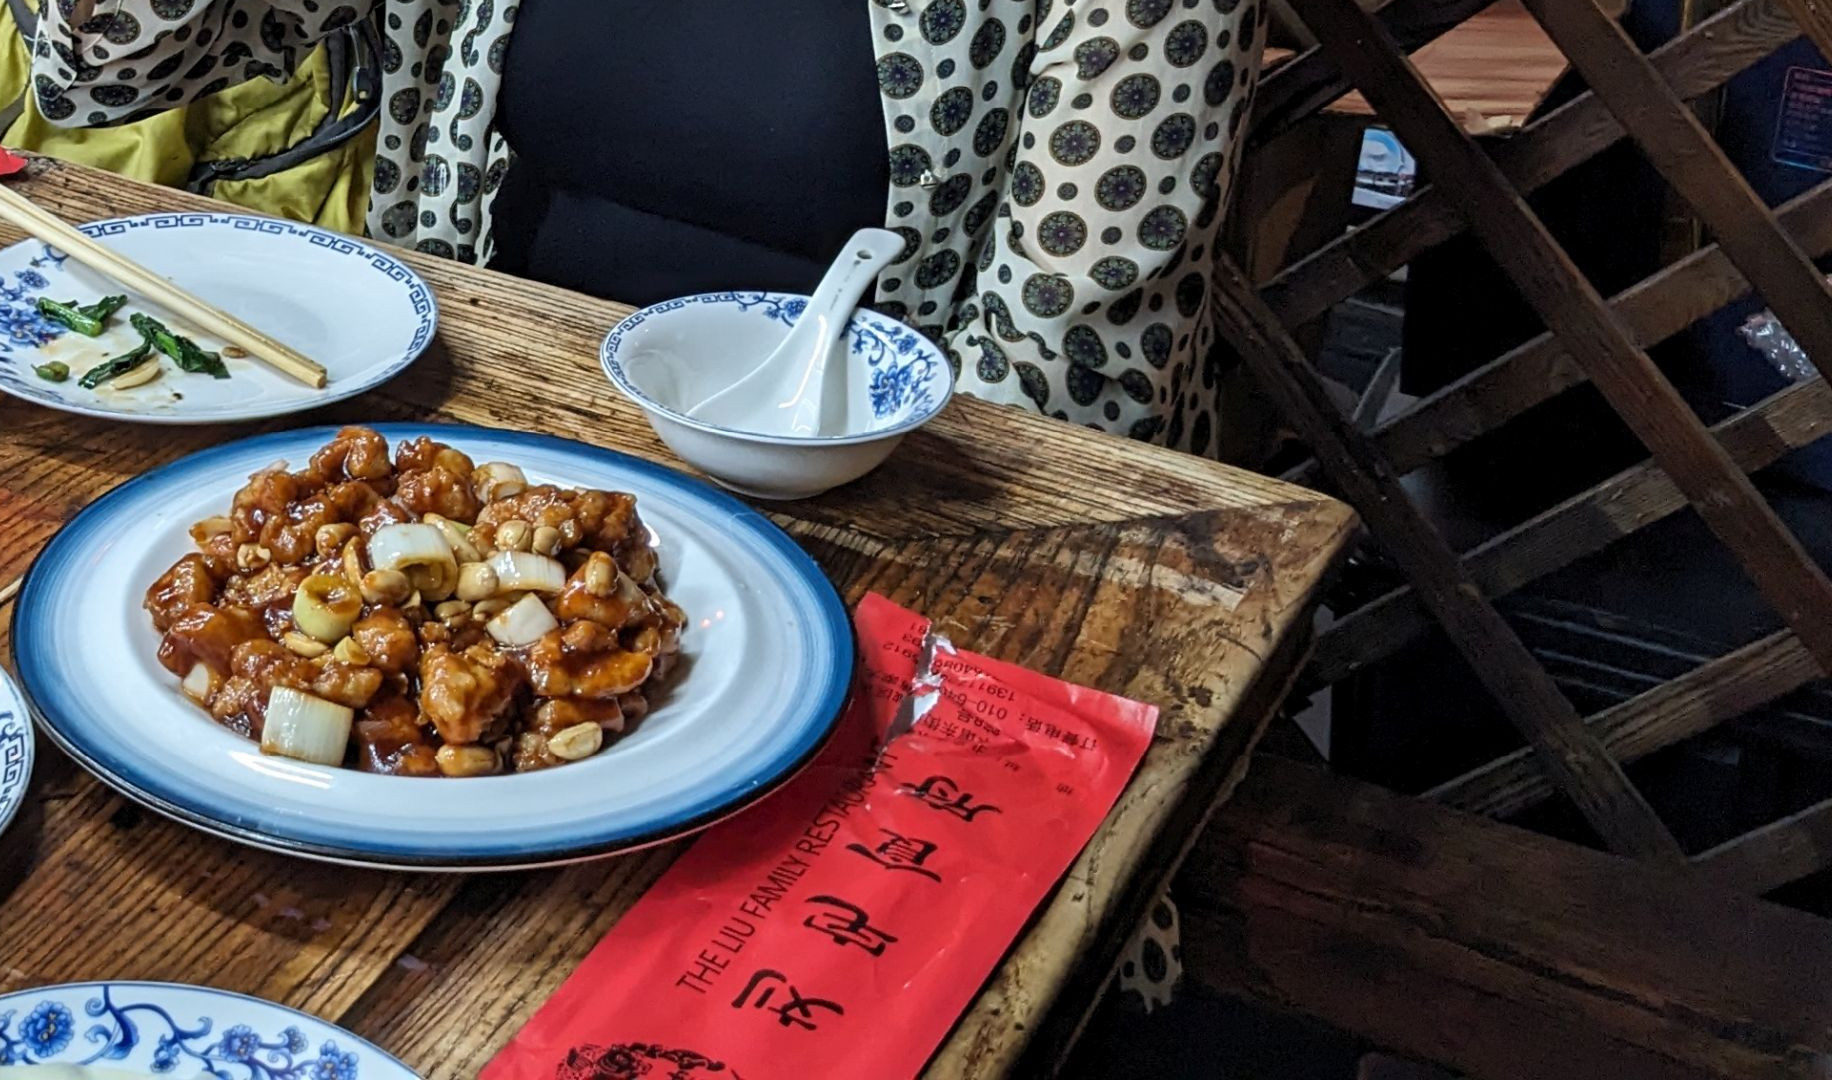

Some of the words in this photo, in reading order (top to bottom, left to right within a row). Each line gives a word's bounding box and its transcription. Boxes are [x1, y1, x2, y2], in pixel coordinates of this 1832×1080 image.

[675, 948, 731, 994] THE
[711, 915, 756, 954] LIU
[739, 855, 812, 920] FAMILY
